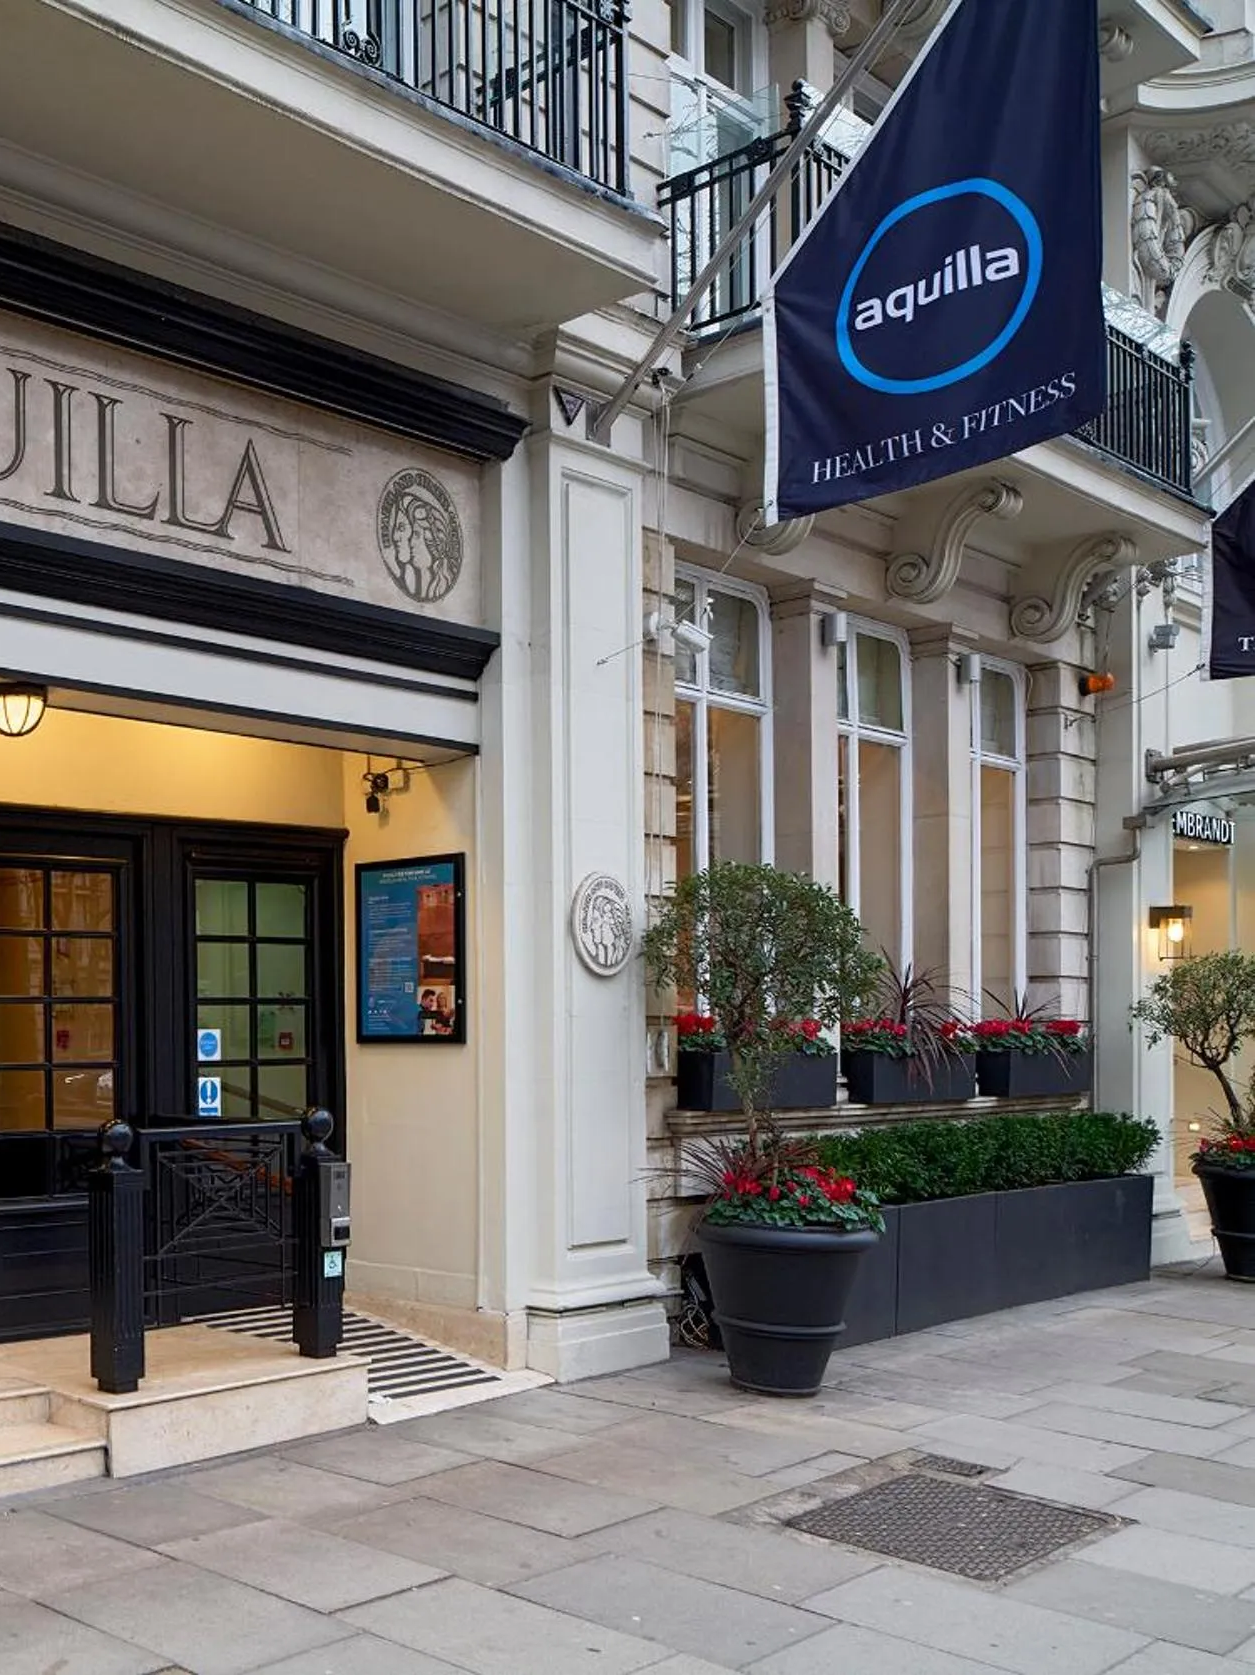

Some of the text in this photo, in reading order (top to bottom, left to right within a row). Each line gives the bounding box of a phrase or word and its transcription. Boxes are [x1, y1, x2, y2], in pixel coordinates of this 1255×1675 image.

[853, 244, 1021, 332] aquilla
[811, 372, 1077, 484] HEALTH & FITNESS
[1238, 636, 1255, 652] T
